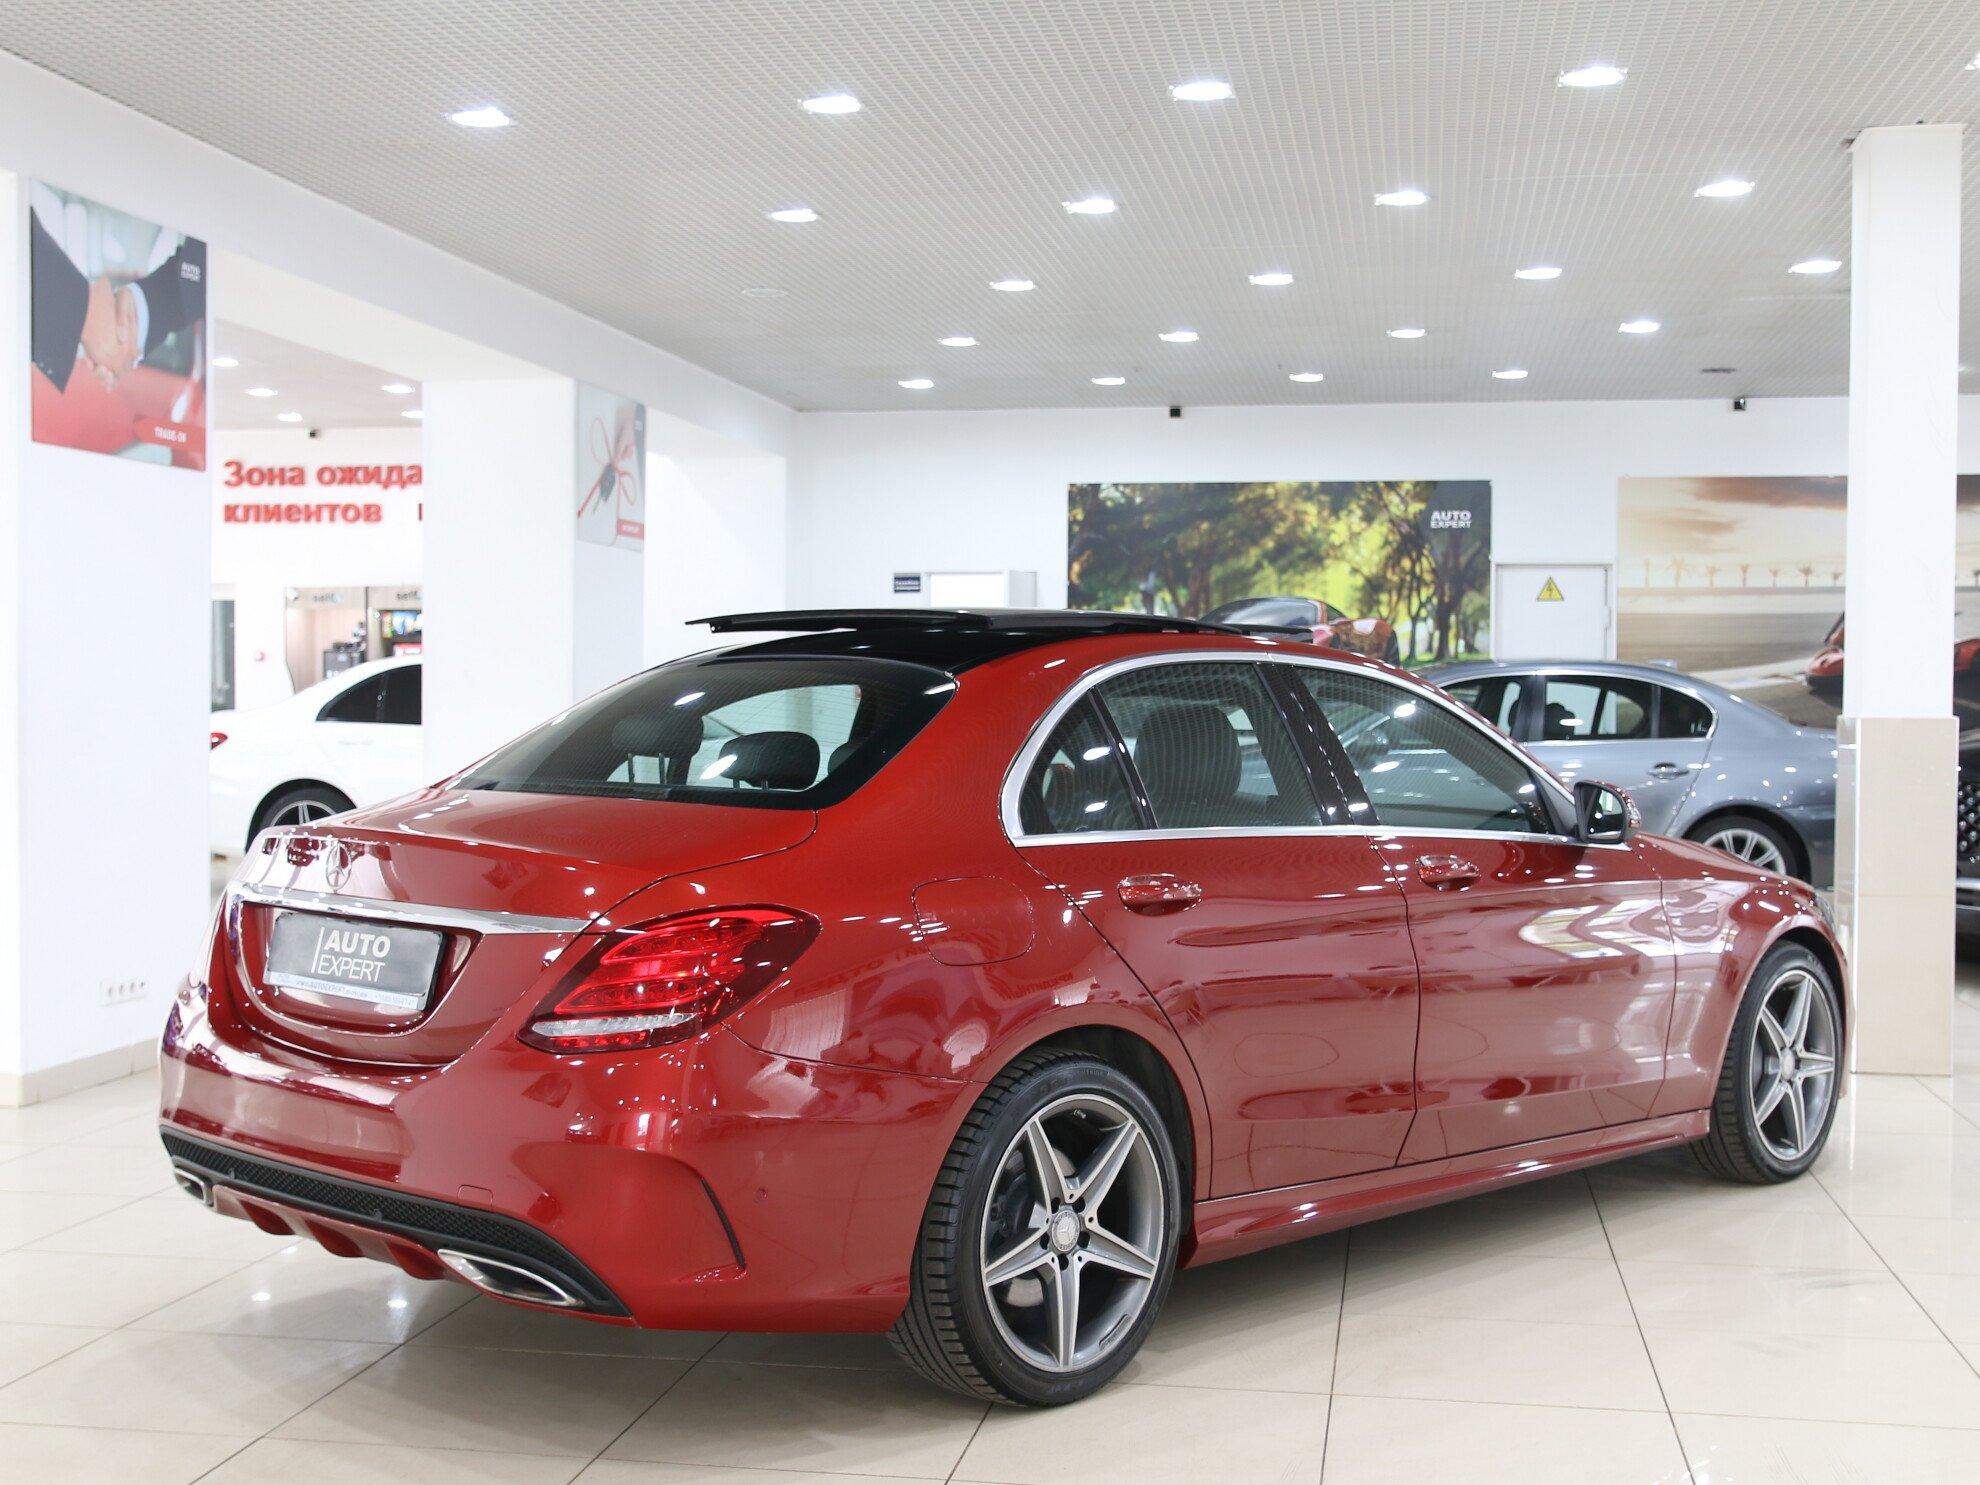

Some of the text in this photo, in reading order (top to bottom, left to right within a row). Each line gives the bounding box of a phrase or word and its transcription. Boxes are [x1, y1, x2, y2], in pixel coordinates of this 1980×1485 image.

[224, 459, 305, 487] Зона
[223, 503, 382, 523] клиентов
[1430, 510, 1471, 521] AUTO
[1430, 520, 1471, 528] EXPERT
[323, 929, 391, 958] AUTO
[317, 954, 386, 983] EXPERT
